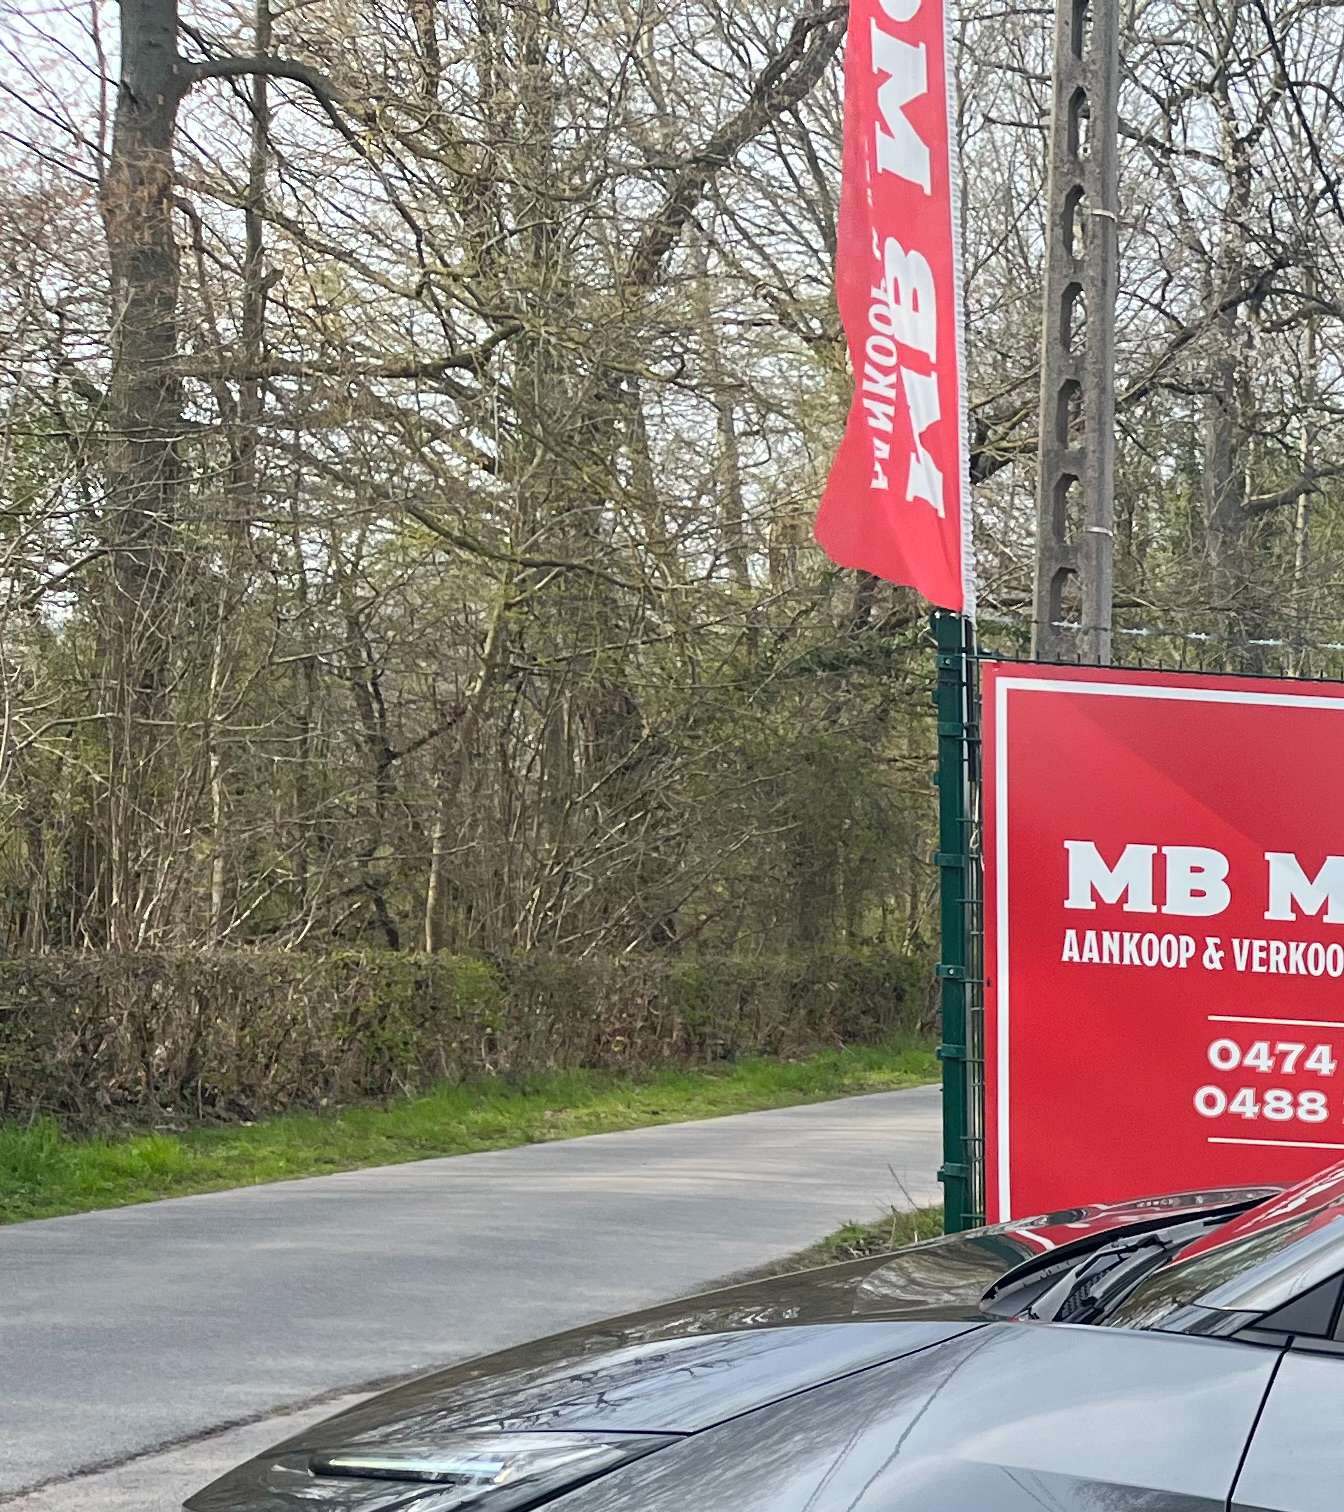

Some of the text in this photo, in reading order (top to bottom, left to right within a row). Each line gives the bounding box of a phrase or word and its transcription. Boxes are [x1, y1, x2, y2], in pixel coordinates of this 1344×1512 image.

[1062, 840, 1232, 918] MB
[1061, 928, 1197, 968] AANKOOP
[1202, 936, 1225, 971] &
[1207, 1038, 1338, 1077] 0474
[1193, 1084, 1329, 1123] 0488
